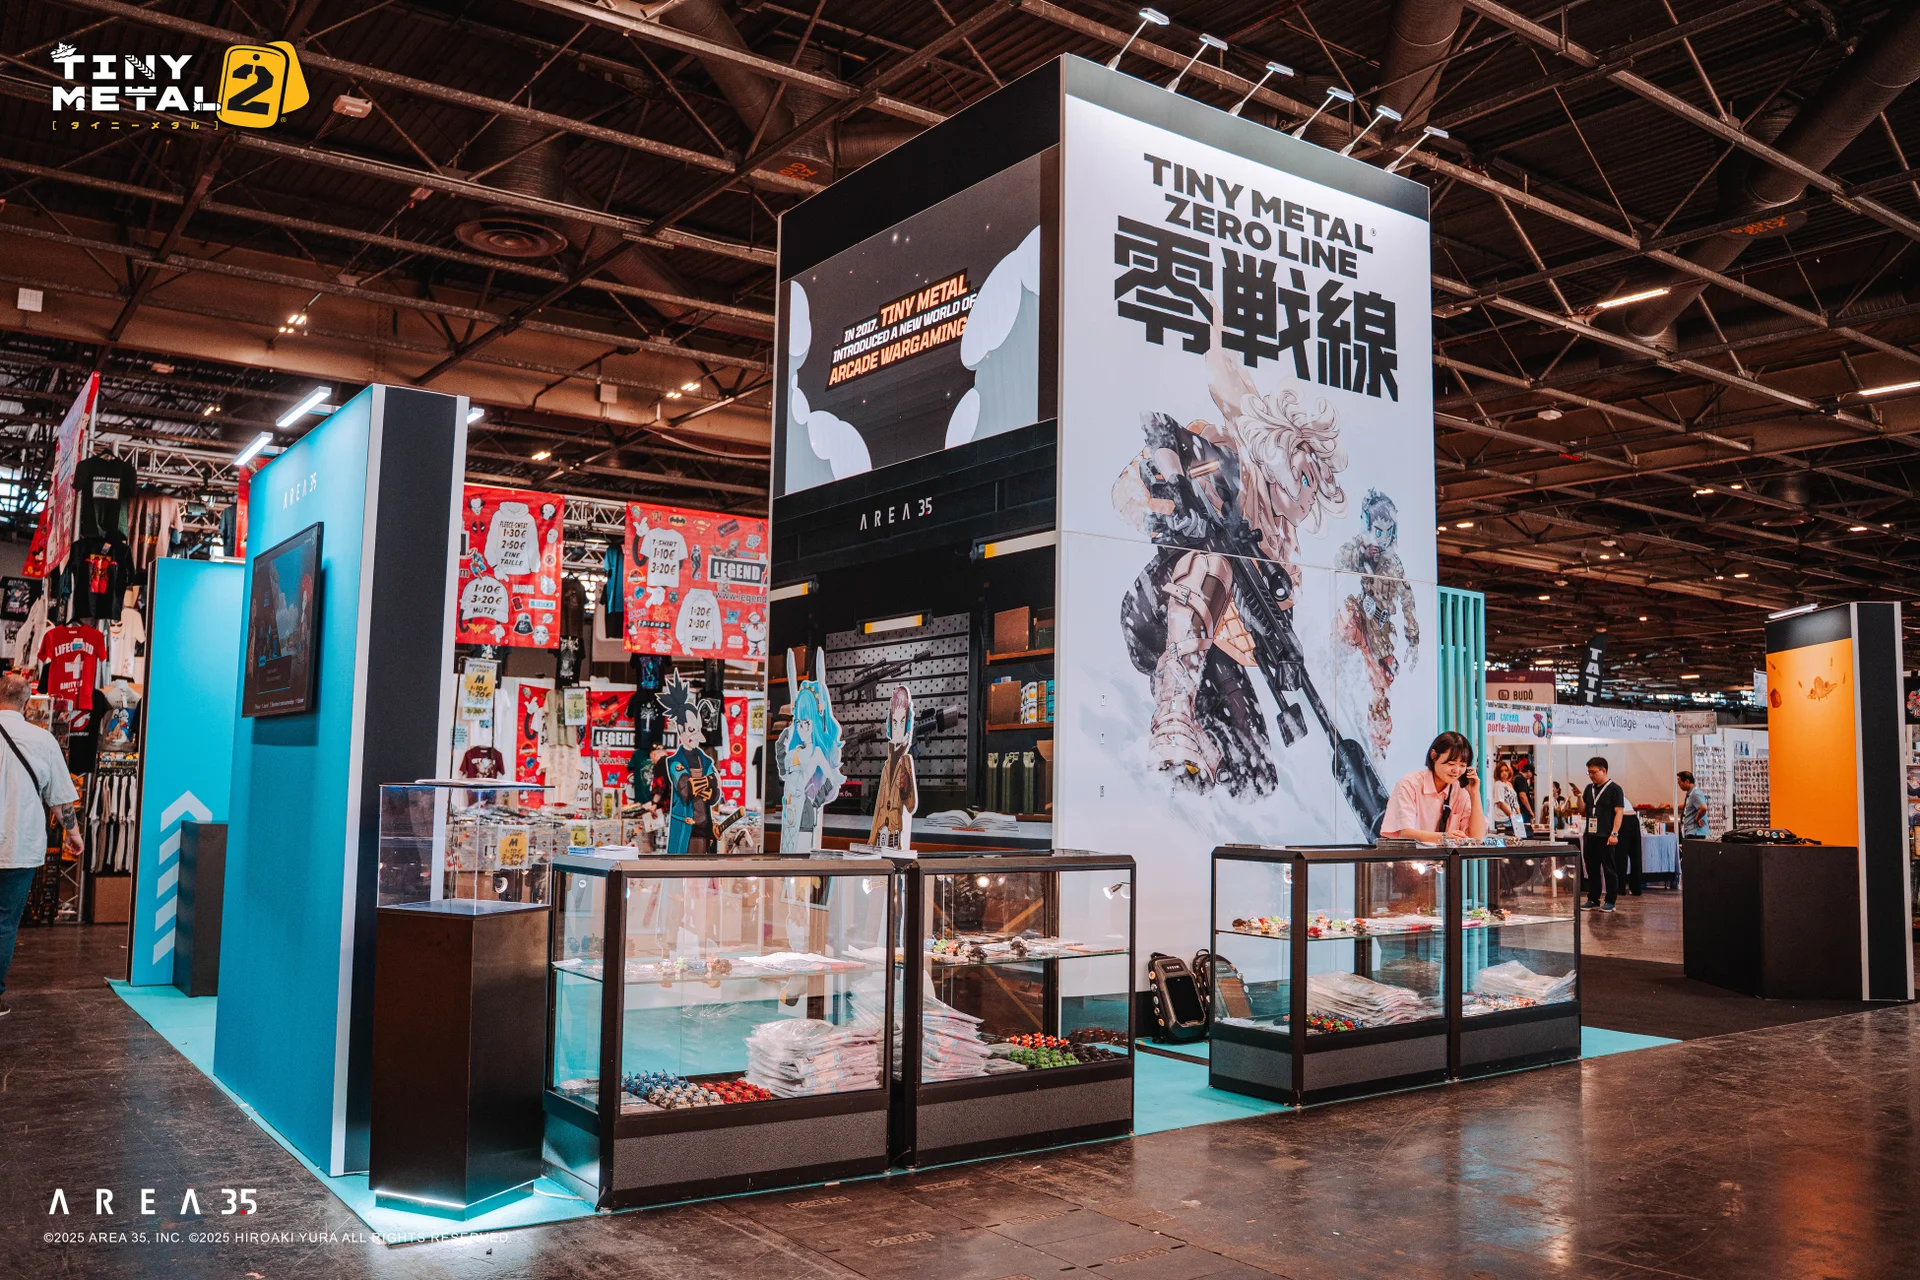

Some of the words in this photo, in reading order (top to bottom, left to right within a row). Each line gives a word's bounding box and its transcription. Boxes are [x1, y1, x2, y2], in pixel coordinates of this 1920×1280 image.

[1144, 152, 1244, 211] TINY
[1251, 189, 1373, 254] METAL
[1165, 193, 1272, 251] ZERO
[1278, 229, 1358, 280] LINE
[832, 329, 890, 364] INTRODUCED
[889, 329, 898, 340] A
[899, 315, 924, 337] NEW
[923, 300, 961, 327] WORLD
[961, 292, 978, 312] OF
[844, 325, 857, 343] IN
[880, 296, 917, 328] TINY
[916, 274, 968, 313] METAL
[828, 350, 880, 386] ARCADE
[880, 315, 969, 366] WARGAMING
[860, 503, 910, 531] AREA
[918, 497, 933, 517] 35
[713, 562, 760, 580] LEGEND
[474, 675, 485, 684] M
[509, 838, 518, 846] M
